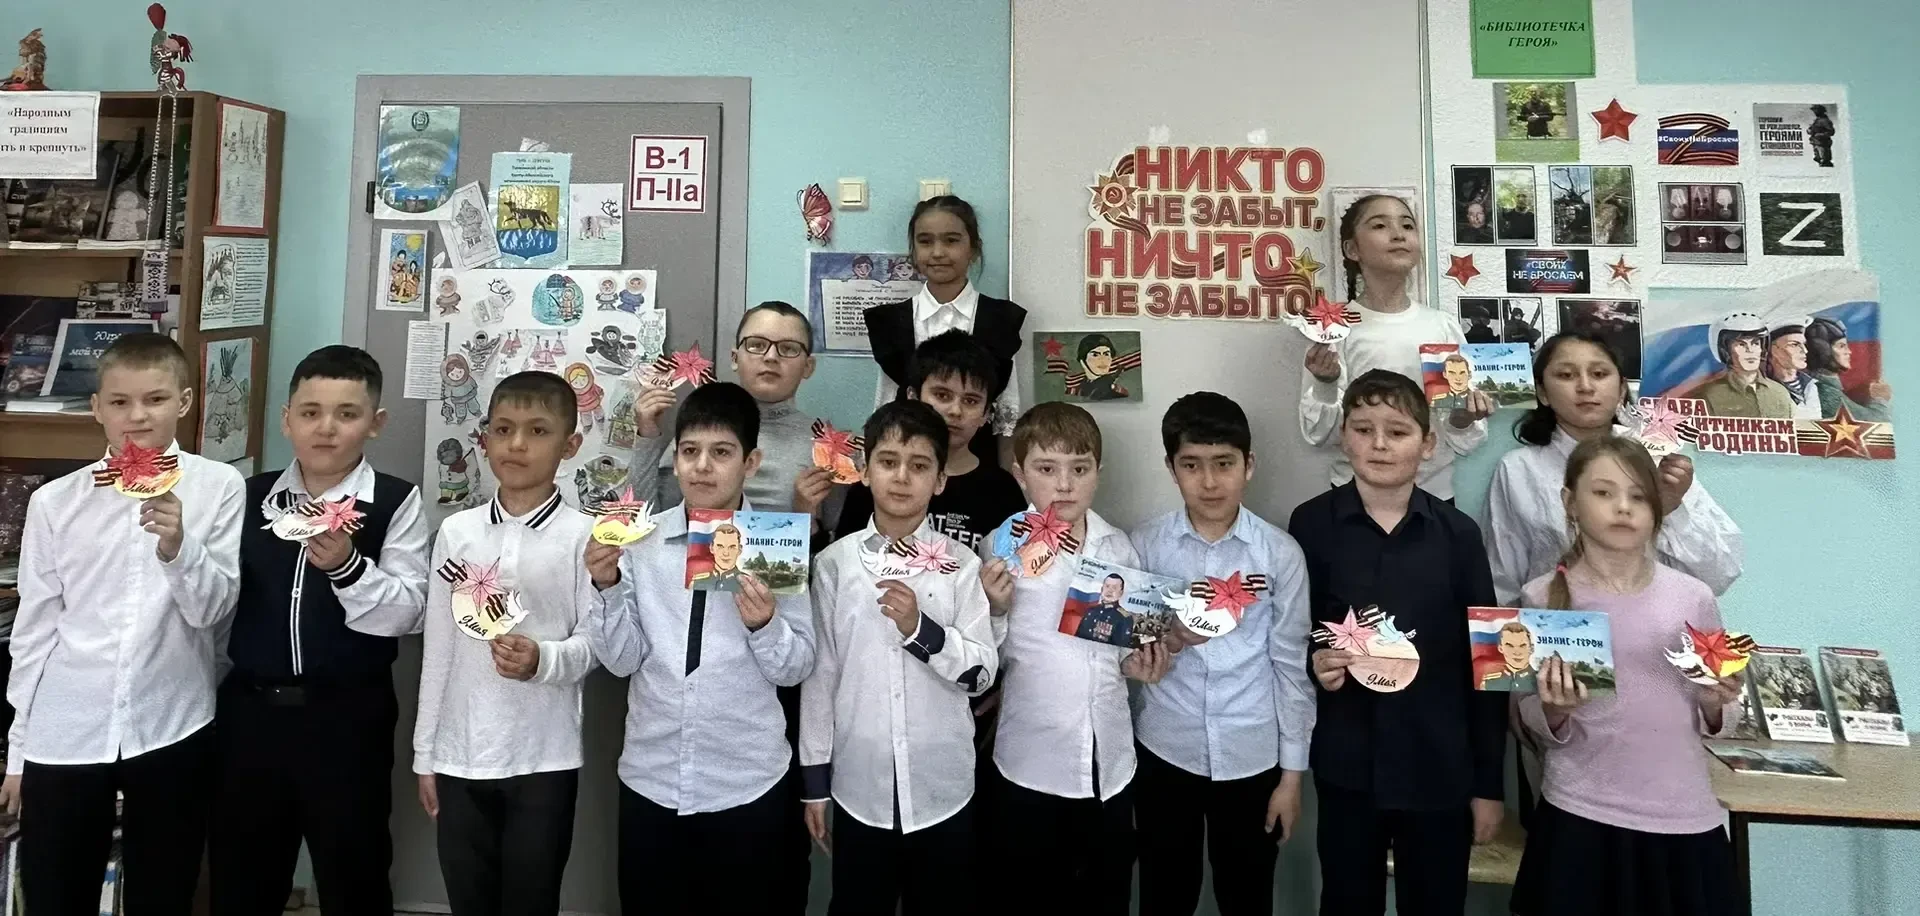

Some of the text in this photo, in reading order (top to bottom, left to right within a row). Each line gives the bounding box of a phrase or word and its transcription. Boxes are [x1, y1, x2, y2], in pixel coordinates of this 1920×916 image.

[1480, 21, 1585, 32] «БИБЛИОТЕЧКА
[1508, 37, 1558, 48] ГЕРОЯ»
[8, 107, 71, 120] «Народным
[646, 146, 689, 169] В-1
[1134, 146, 1325, 193] НИКТО
[1137, 195, 1326, 231] НЕ ЗАБЫТ,
[1087, 228, 1296, 281] НИЧТО
[1512, 271, 1528, 279] НЕ
[1086, 283, 1139, 316] НЕ
[1698, 433, 1797, 455] РОДИНЫ
